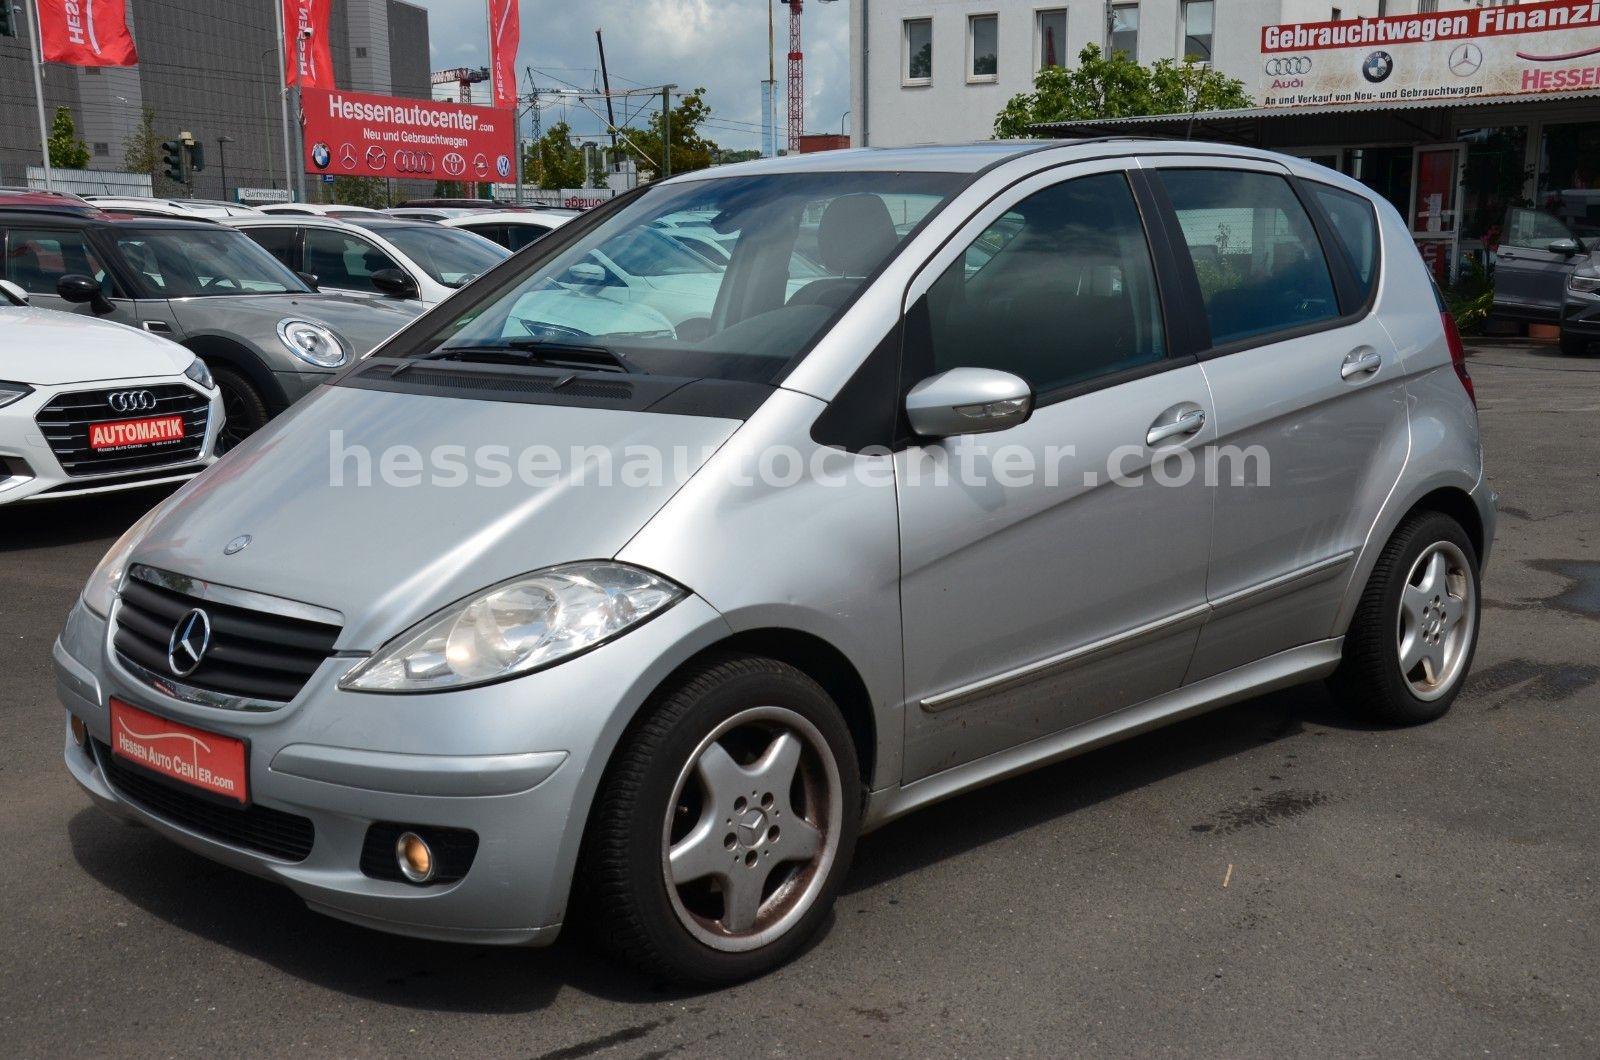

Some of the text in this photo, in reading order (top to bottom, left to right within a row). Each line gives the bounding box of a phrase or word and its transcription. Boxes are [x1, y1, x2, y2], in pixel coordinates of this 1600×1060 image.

[1265, 16, 1469, 50] Gebrauchtwagen
[1271, 78, 1304, 90] Audi
[1521, 67, 1600, 90] HESSE
[1264, 85, 1483, 105] An und Verkauf von Neu- und Gebrauchtwagen
[363, 127, 468, 149] Neu und Gebrauchtwagen
[93, 418, 183, 446] AUTOMATIK
